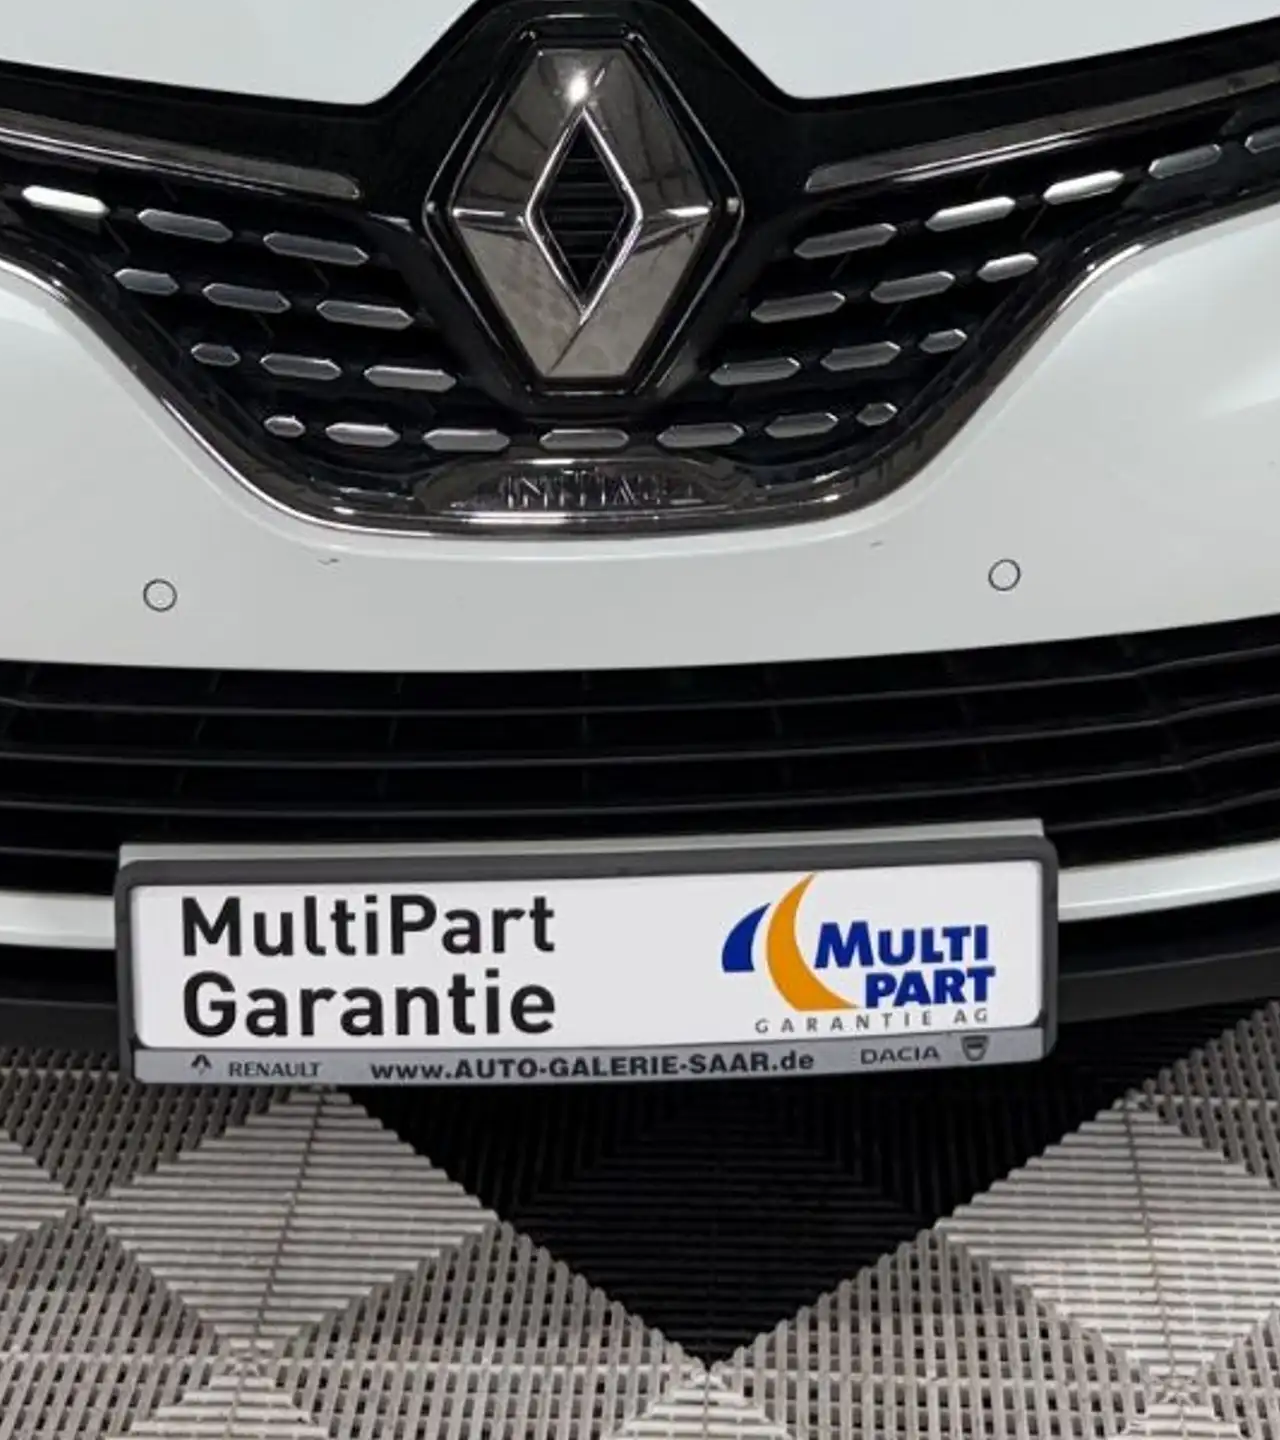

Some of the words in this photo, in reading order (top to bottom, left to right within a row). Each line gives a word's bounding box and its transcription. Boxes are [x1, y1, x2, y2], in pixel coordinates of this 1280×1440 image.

[182, 894, 555, 958] MultiPart
[815, 921, 989, 969] MULTI
[183, 967, 555, 1037] Garantie
[865, 966, 996, 1008] PART
[755, 1010, 933, 1034] GARANTIE
[953, 1008, 989, 1024] AG
[228, 1060, 320, 1077] RENAULT
[370, 1050, 815, 1079] www.AUTO-GALERIE-SAAR.de
[860, 1046, 941, 1066] DACIA
